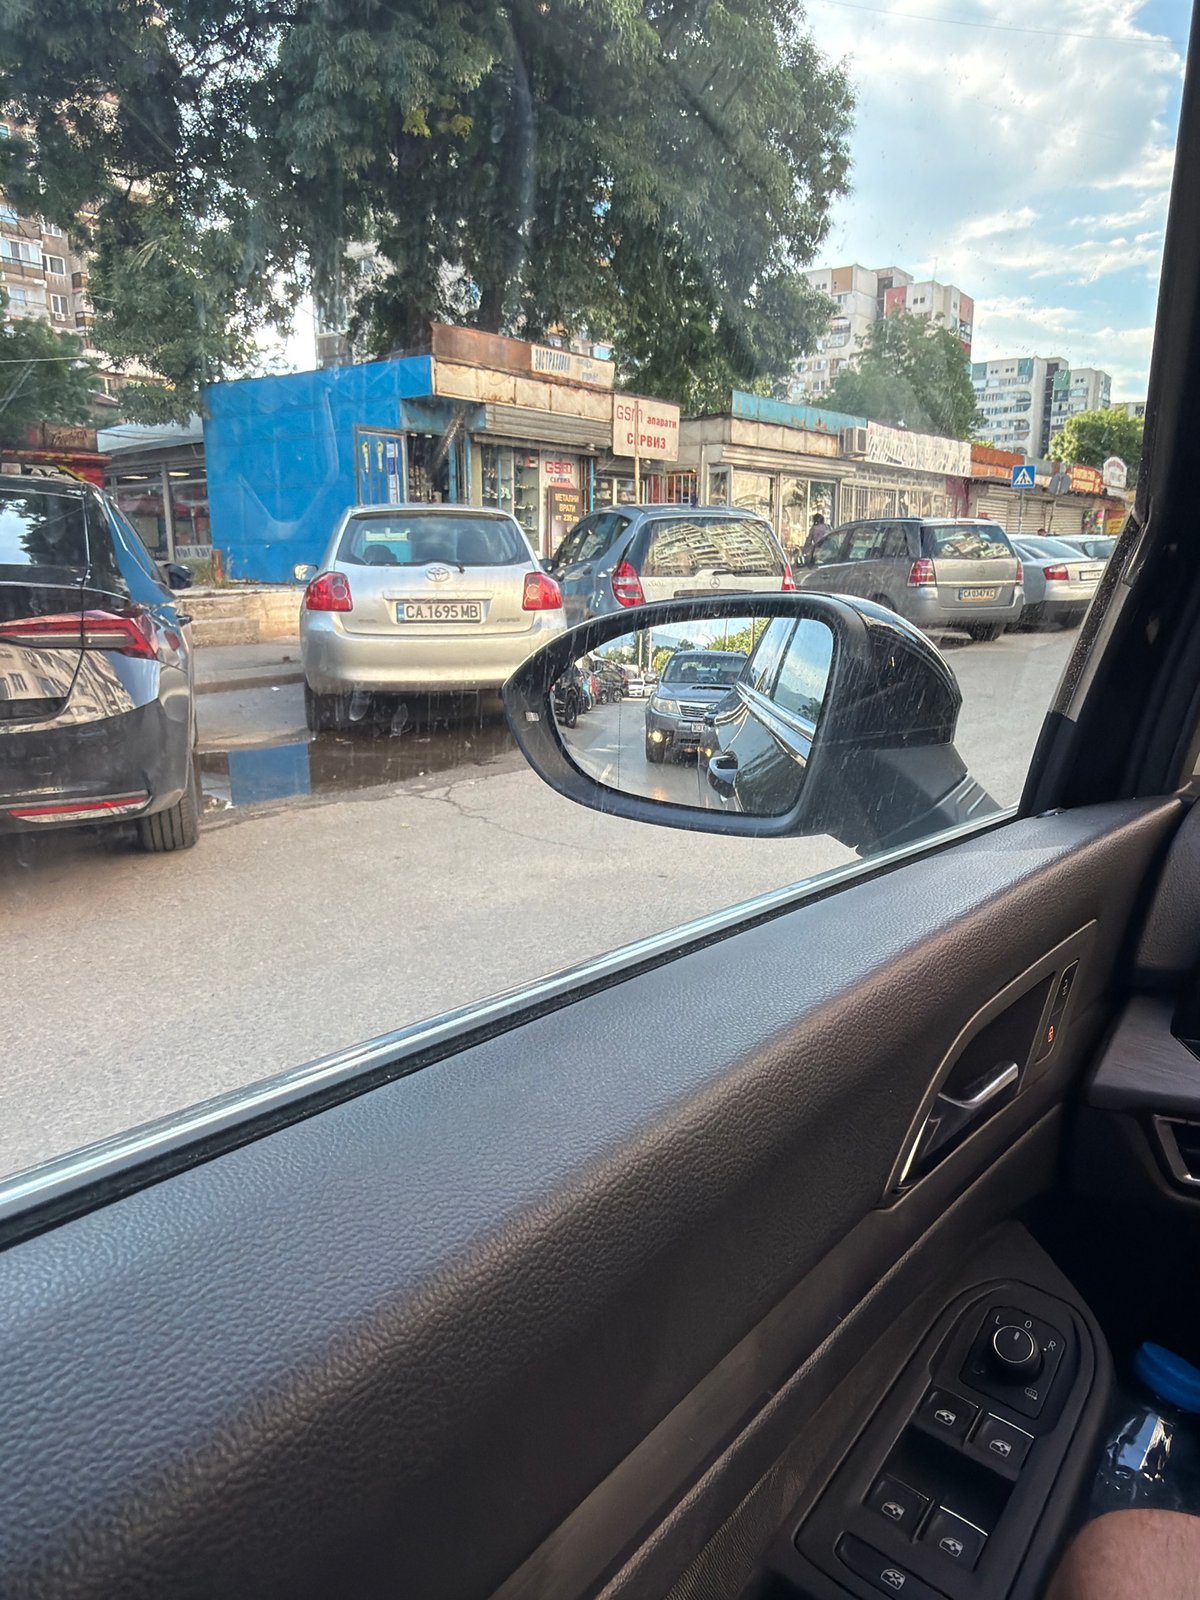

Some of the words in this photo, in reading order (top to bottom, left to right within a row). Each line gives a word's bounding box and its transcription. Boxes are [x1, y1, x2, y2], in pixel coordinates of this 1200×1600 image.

[647, 416, 678, 430] апарати
[559, 503, 576, 513] ВРАТИ
[995, 1314, 1000, 1325] L
[1047, 1340, 1057, 1351] R
